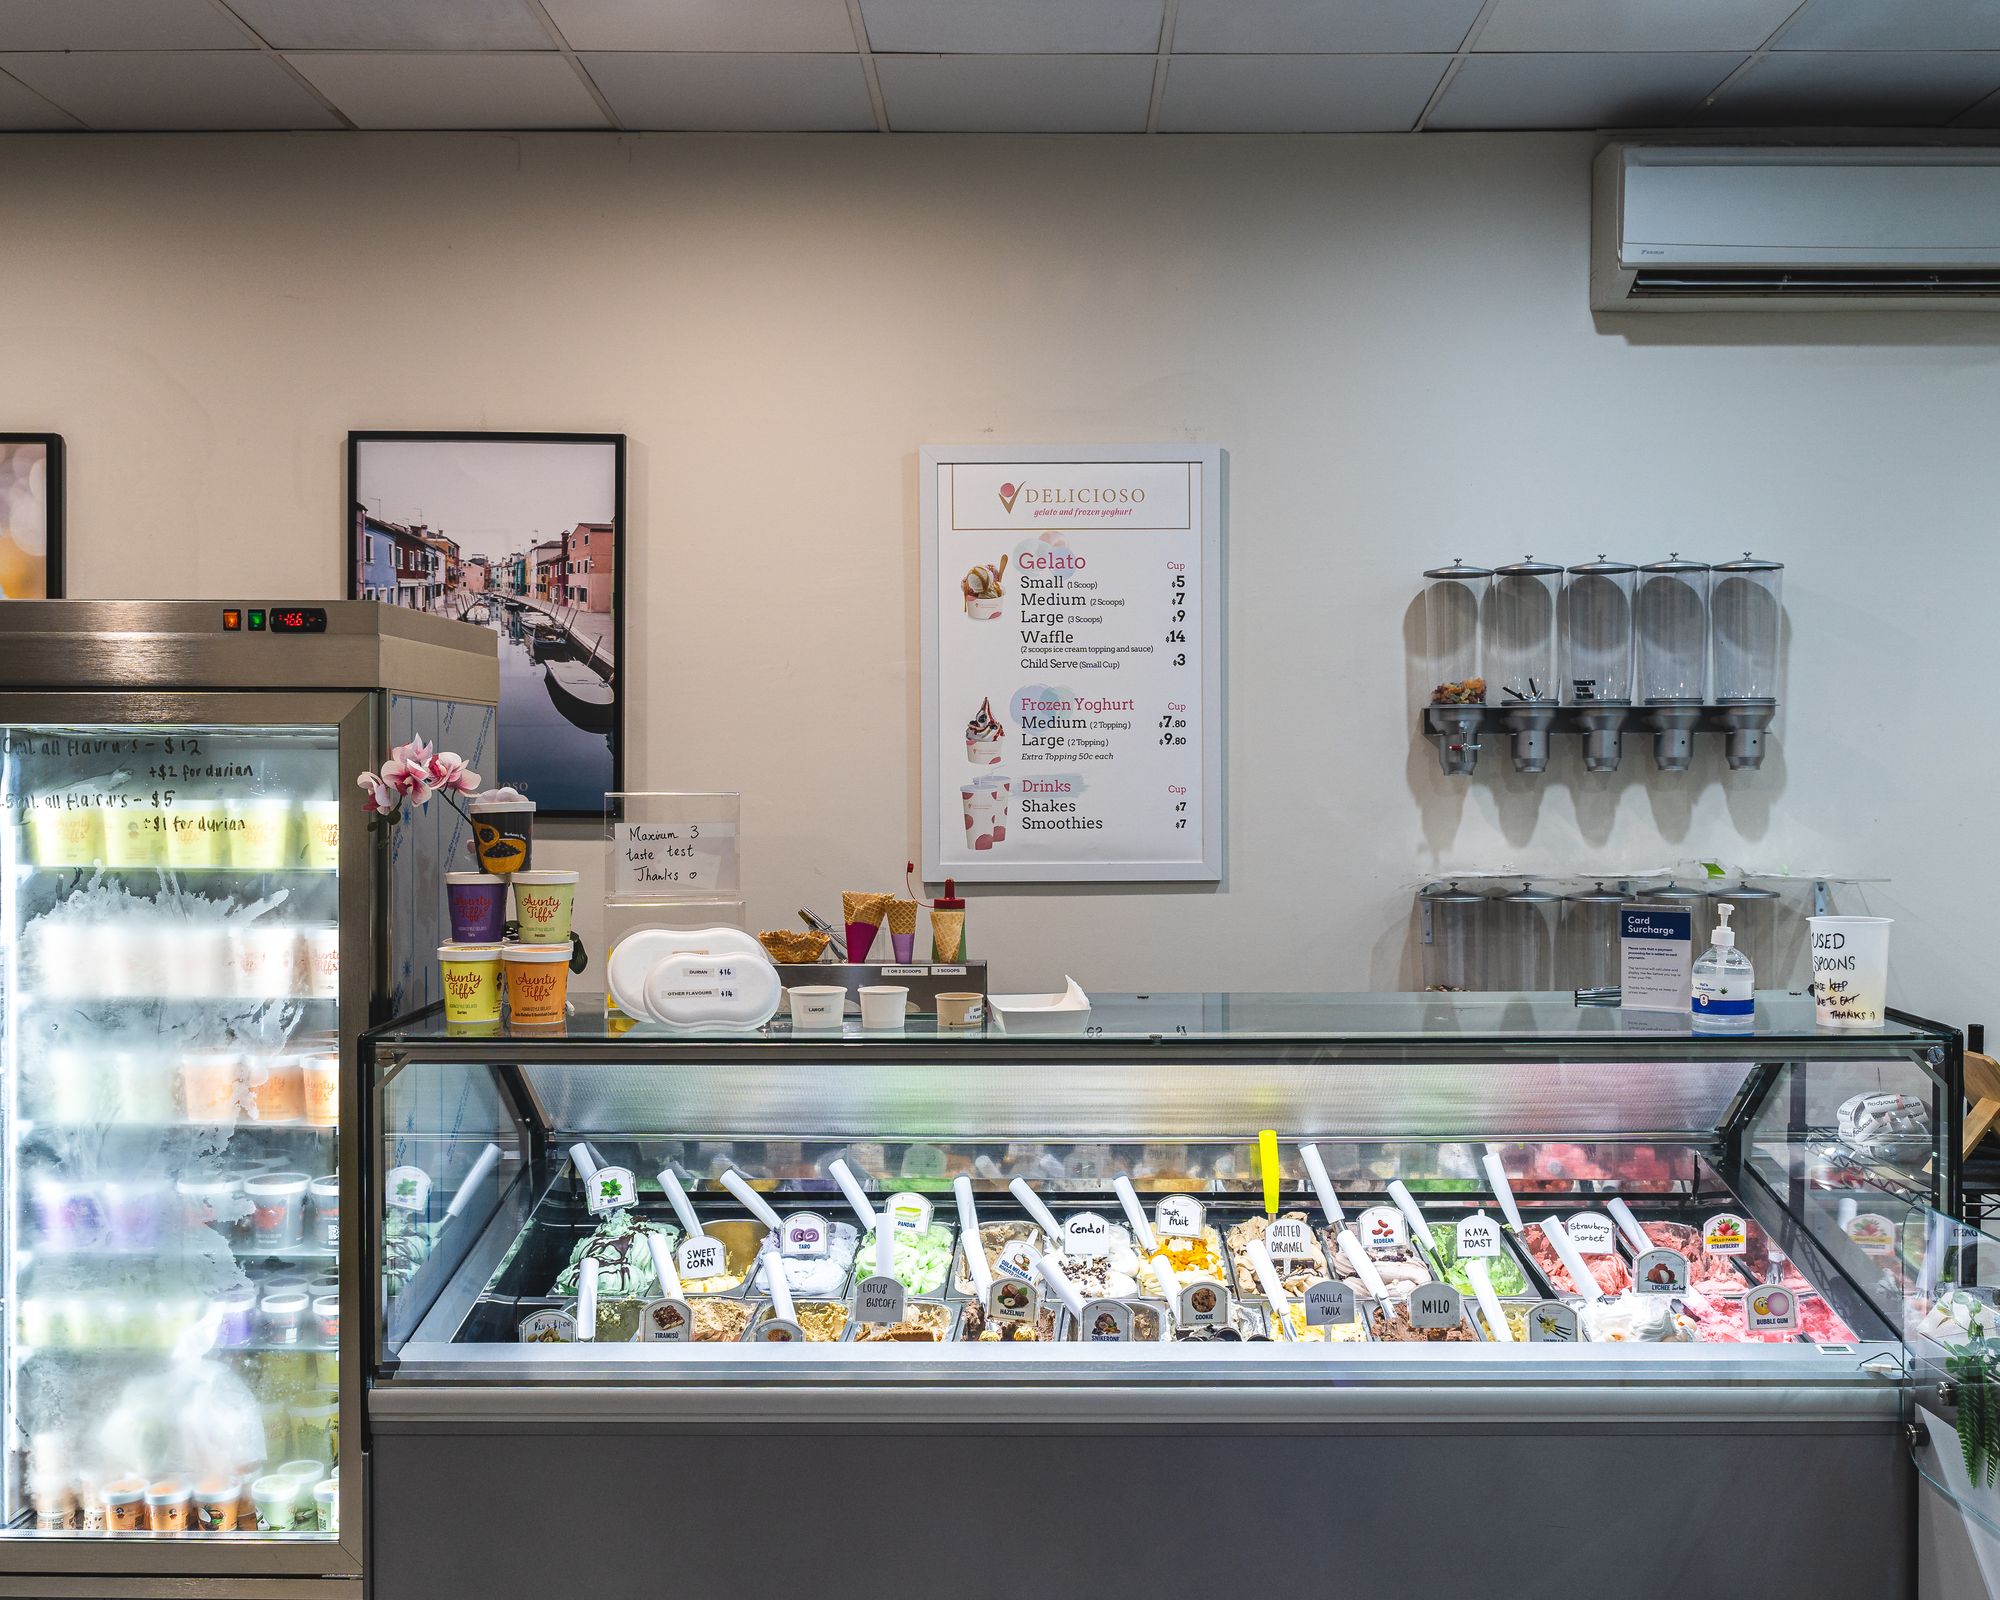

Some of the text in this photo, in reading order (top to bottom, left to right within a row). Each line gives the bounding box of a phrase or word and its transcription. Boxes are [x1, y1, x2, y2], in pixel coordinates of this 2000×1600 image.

[1025, 488, 1145, 503] DELICIOSO
[1034, 508, 1132, 518] gelato and frozen yoghurt
[1019, 552, 1086, 570] Gelato
[1167, 561, 1186, 571] Cup
[1020, 575, 1063, 588] Small
[1074, 581, 1098, 590] Scoop)
[1171, 575, 1186, 588] $5
[1020, 593, 1087, 606] Medium
[1097, 598, 1125, 607] Scoops)
[1171, 593, 1186, 605] $7
[1021, 610, 1064, 626] Large
[1075, 615, 1103, 624] Scoops)
[1172, 610, 1186, 623] $9
[1020, 630, 1074, 644] Waffle
[1165, 630, 1186, 644] $14
[1028, 646, 1053, 654] scoops
[1088, 646, 1115, 654] topping
[1130, 645, 1154, 653] sauce)
[1020, 659, 1120, 670] Child Serve (Small Cup)
[1172, 654, 1186, 667] $3
[1021, 697, 1135, 713] Frozen Yoghurt
[1167, 702, 1187, 712] Cup
[1021, 716, 1087, 729] Medium
[1158, 715, 1187, 728] $7.80
[1021, 733, 1065, 749] Large
[1159, 732, 1187, 745] $9.80
[41, 740, 60, 755] all
[1044, 753, 1077, 762] Topping
[182, 764, 201, 781] for
[206, 762, 254, 778] durian
[1022, 780, 1071, 793] Drinks
[1168, 785, 1187, 795] Cup
[45, 793, 60, 809] all
[151, 790, 176, 808] $5
[1021, 800, 1076, 813] Shakes
[1175, 802, 1187, 812] $7
[198, 816, 245, 832] durian
[1022, 817, 1103, 830] Smoothies
[1175, 819, 1187, 829] $7
[690, 825, 700, 839] 3
[626, 844, 695, 861] taste test
[634, 866, 679, 882] Thanks
[521, 893, 561, 912] Aunty
[527, 907, 554, 922] Tiffs
[1627, 916, 1650, 925] Card
[1627, 925, 1675, 937] Surcharge
[1811, 933, 1845, 949] USED
[1813, 956, 1856, 971] SPOONS
[444, 969, 483, 988] Aunty
[515, 972, 557, 990] Aunty
[448, 982, 476, 999] Tiffs
[521, 985, 551, 1001] Tiffs
[1830, 1010, 1866, 1020] THANKS
[1162, 1208, 1180, 1217] Jack
[897, 1220, 916, 1228] PANDAN
[1070, 1222, 1105, 1235] Cendol
[1272, 1225, 1301, 1237] SALTED
[1465, 1228, 1490, 1237] KAYA
[1271, 1241, 1304, 1253] CARAMEL
[1463, 1238, 1493, 1248] TOAST
[686, 1247, 716, 1260] SWEET
[686, 1258, 714, 1269] CORN
[862, 1283, 888, 1294] LOTUS
[866, 1298, 897, 1309] BISCOFF
[1309, 1293, 1343, 1303] VANILLA
[1000, 1308, 1025, 1317] HAZELNUT
[1320, 1305, 1341, 1316] TWIX
[1421, 1300, 1450, 1314] MILO
[1195, 1313, 1214, 1321] COOKIE
